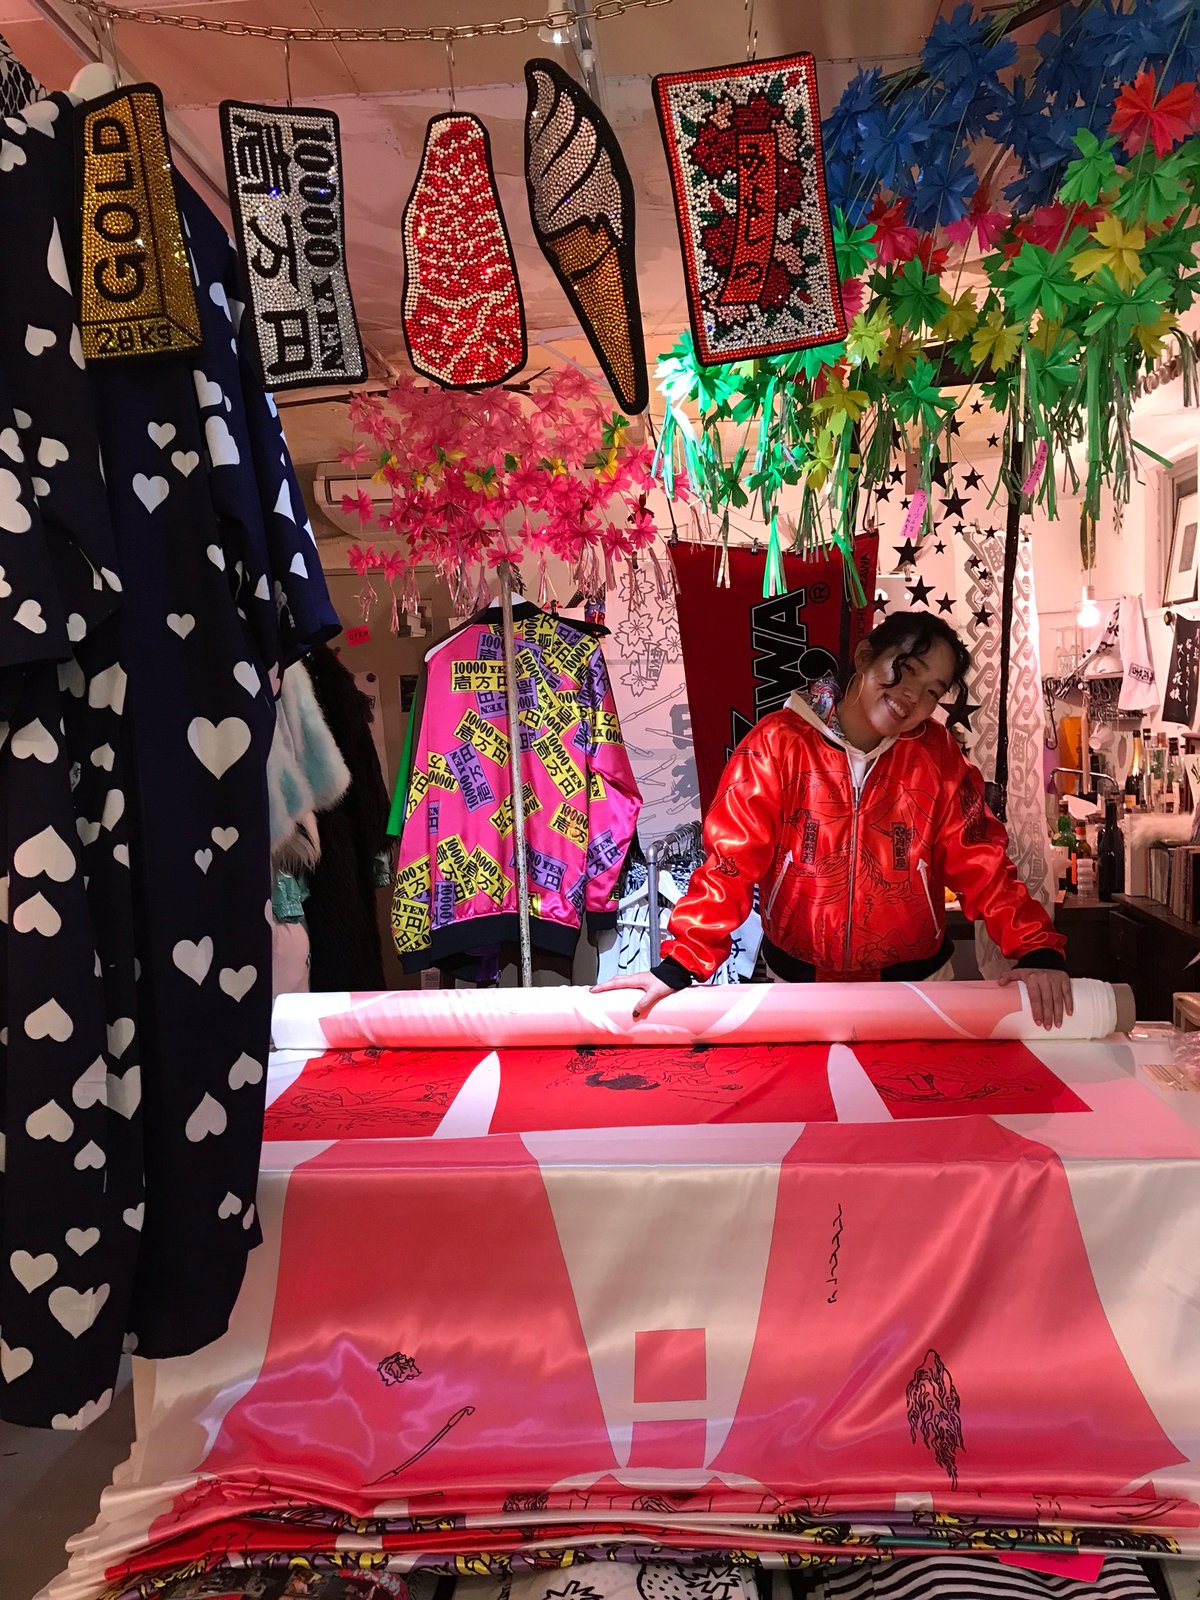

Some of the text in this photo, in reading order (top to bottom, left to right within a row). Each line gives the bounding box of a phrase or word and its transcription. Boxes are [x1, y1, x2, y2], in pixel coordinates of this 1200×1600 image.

[92, 116, 145, 303] GOLD
[291, 125, 348, 374] 10000 YEN
[454, 661, 507, 674] 10000 YE
[464, 711, 494, 737] 10000
[547, 733, 570, 766] 10000
[403, 903, 426, 916] YEN
